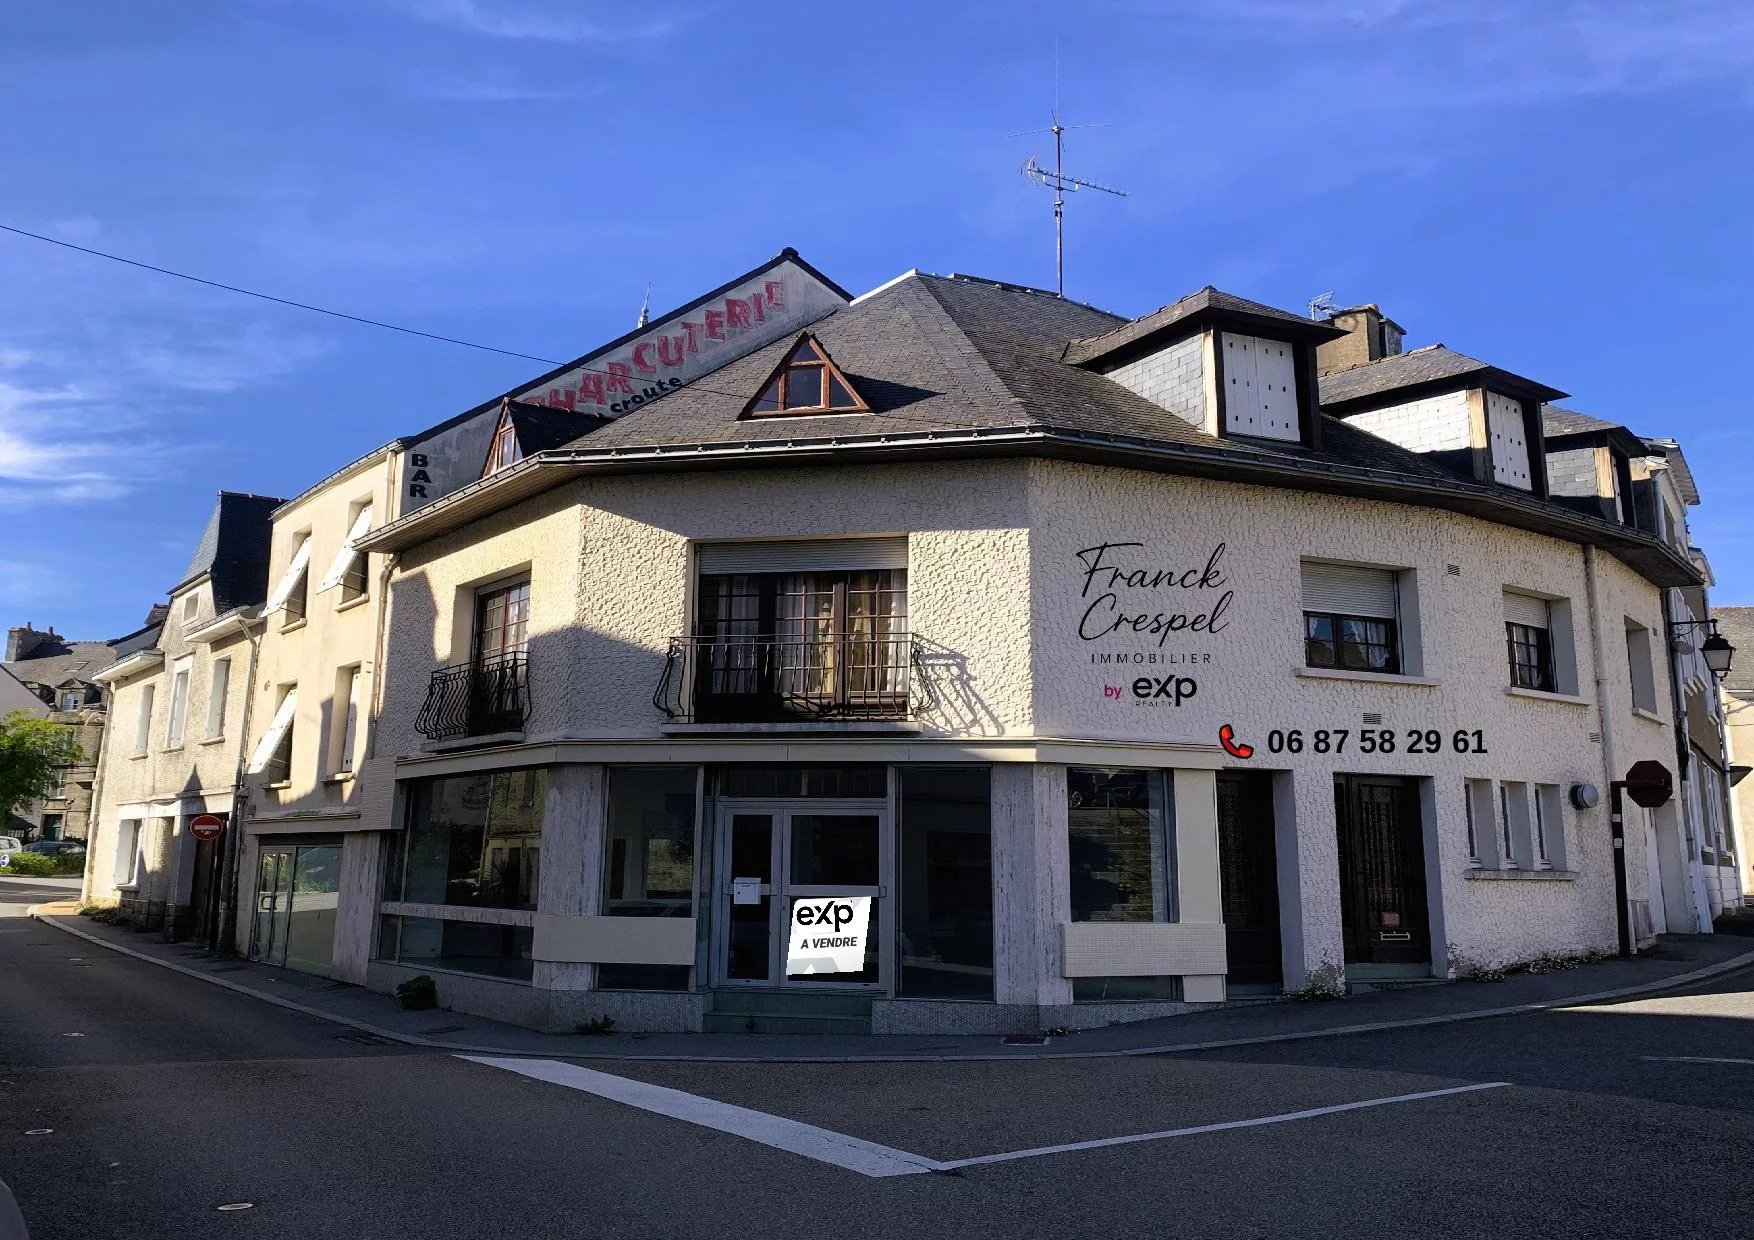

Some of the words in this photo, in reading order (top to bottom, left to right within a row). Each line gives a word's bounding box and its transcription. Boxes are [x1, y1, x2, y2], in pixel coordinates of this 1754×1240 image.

[523, 281, 784, 410] HARCUTERIE
[610, 377, 683, 413] croute
[410, 453, 432, 498] BAR
[800, 938, 809, 949] A
[812, 936, 858, 949] VENDRE
